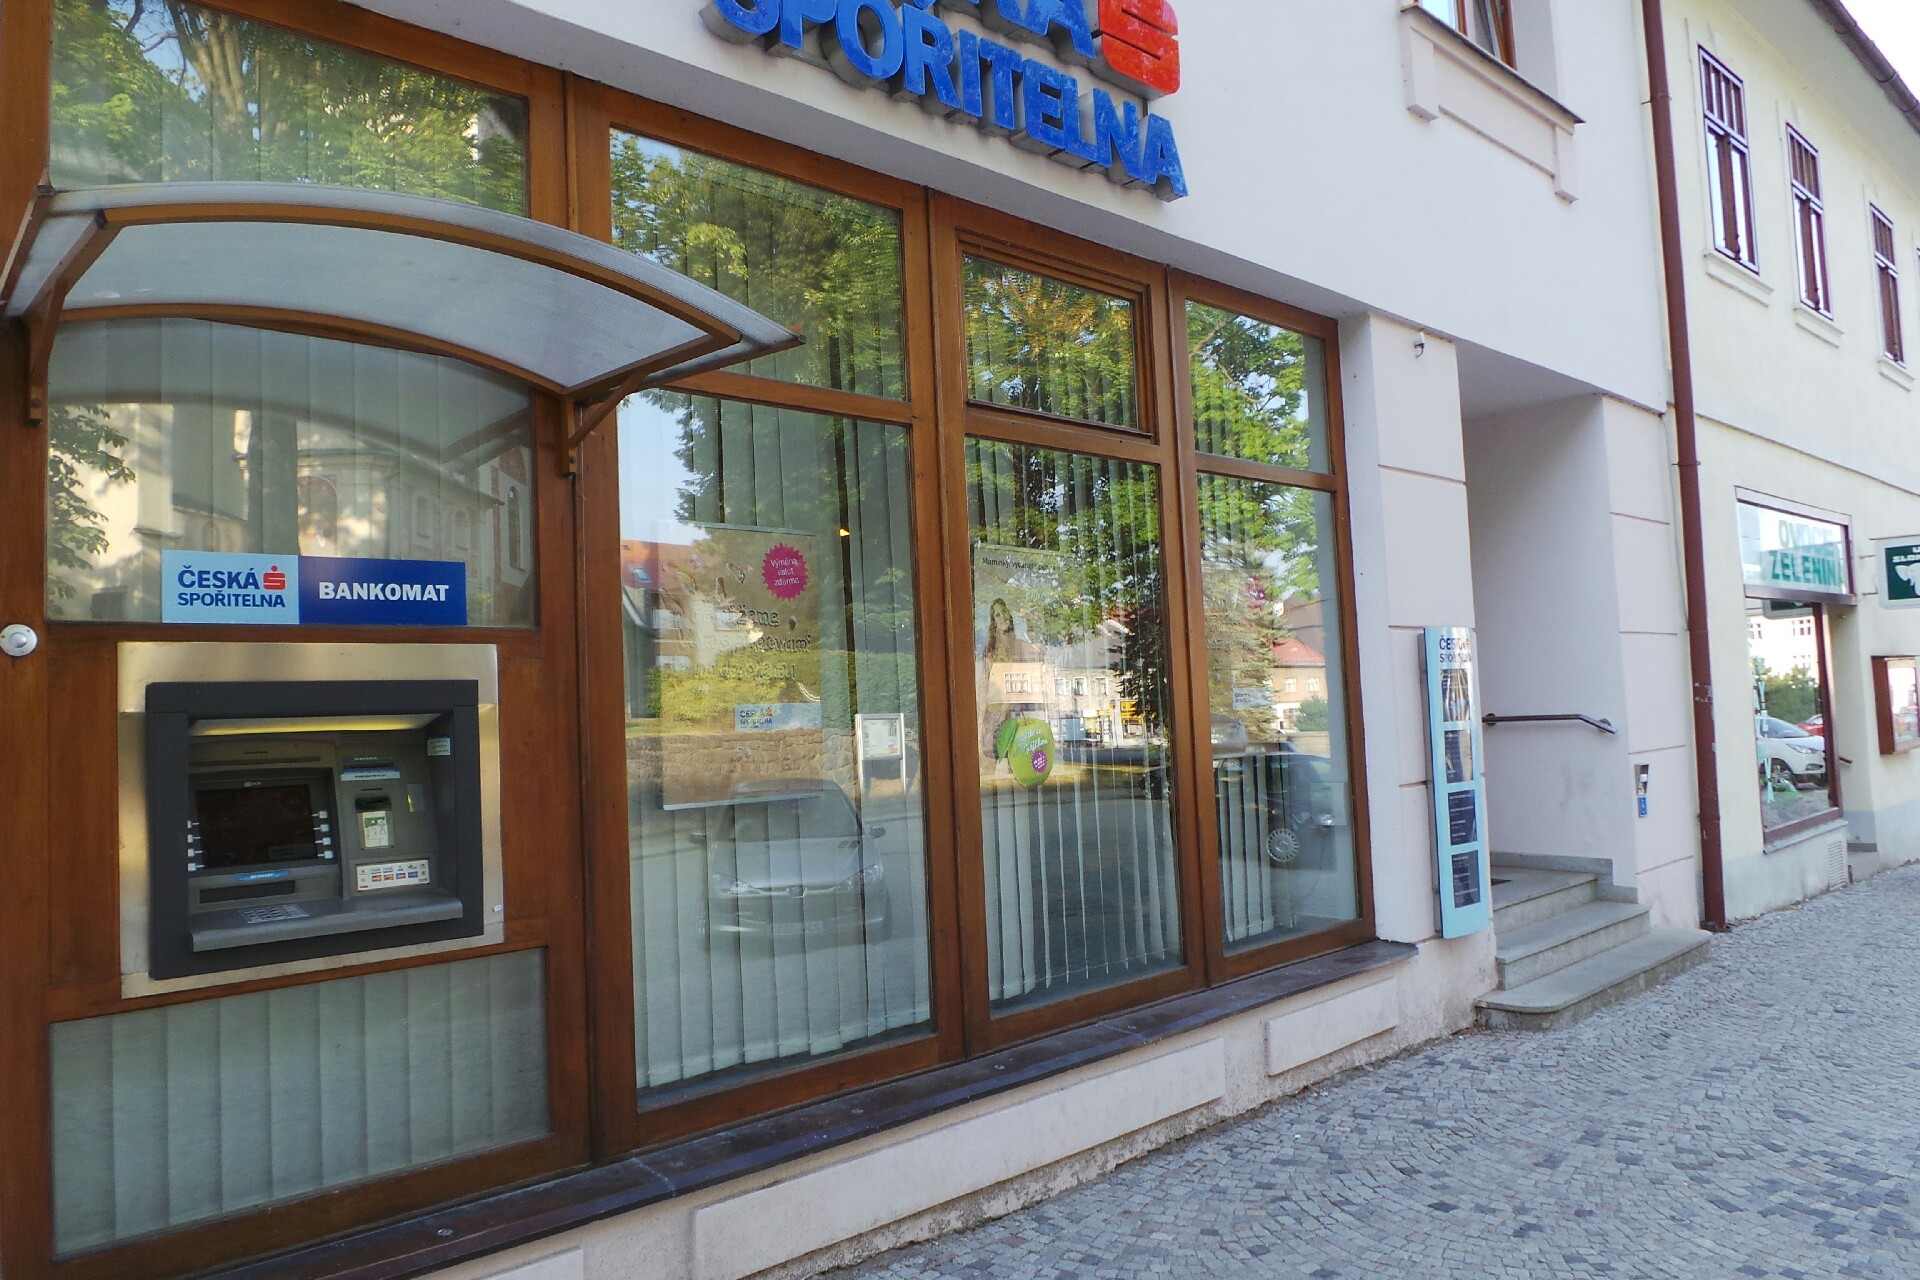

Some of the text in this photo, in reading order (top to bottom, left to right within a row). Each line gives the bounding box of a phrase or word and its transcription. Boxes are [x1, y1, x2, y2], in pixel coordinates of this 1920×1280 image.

[770, 558, 798, 568] Výměna
[177, 565, 260, 590] ČESKÁ
[774, 577, 800, 586] zdarma
[177, 590, 286, 608] SPOŘITELNA
[319, 582, 449, 601] BANKOMAT
